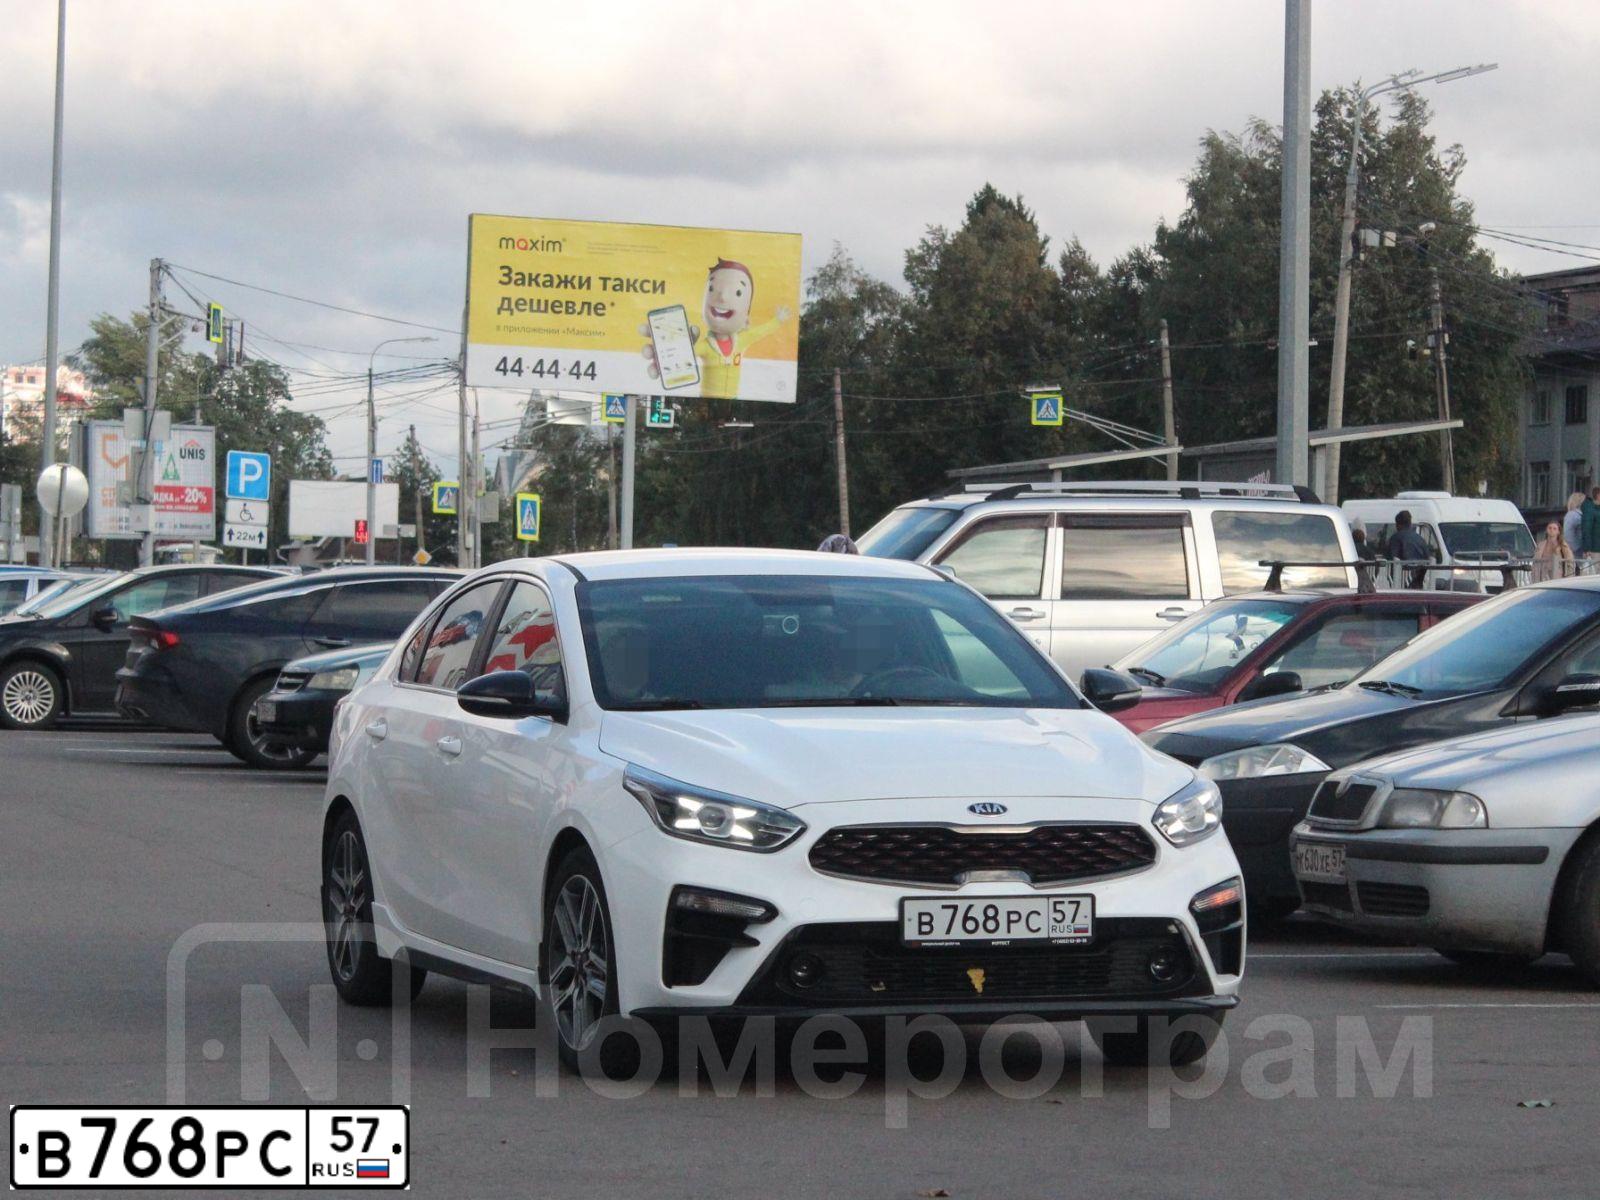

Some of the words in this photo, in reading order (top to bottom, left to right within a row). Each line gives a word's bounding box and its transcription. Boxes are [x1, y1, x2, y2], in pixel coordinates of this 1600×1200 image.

[498, 236, 562, 253] maxim
[498, 265, 592, 291] Закажи
[598, 275, 666, 295] такси
[503, 325, 560, 336] приложении
[179, 447, 206, 460] UNIS
[239, 457, 263, 494] P
[974, 803, 1005, 814] KIA
[1052, 900, 1081, 924] 57
[1051, 924, 1073, 934] RUS
